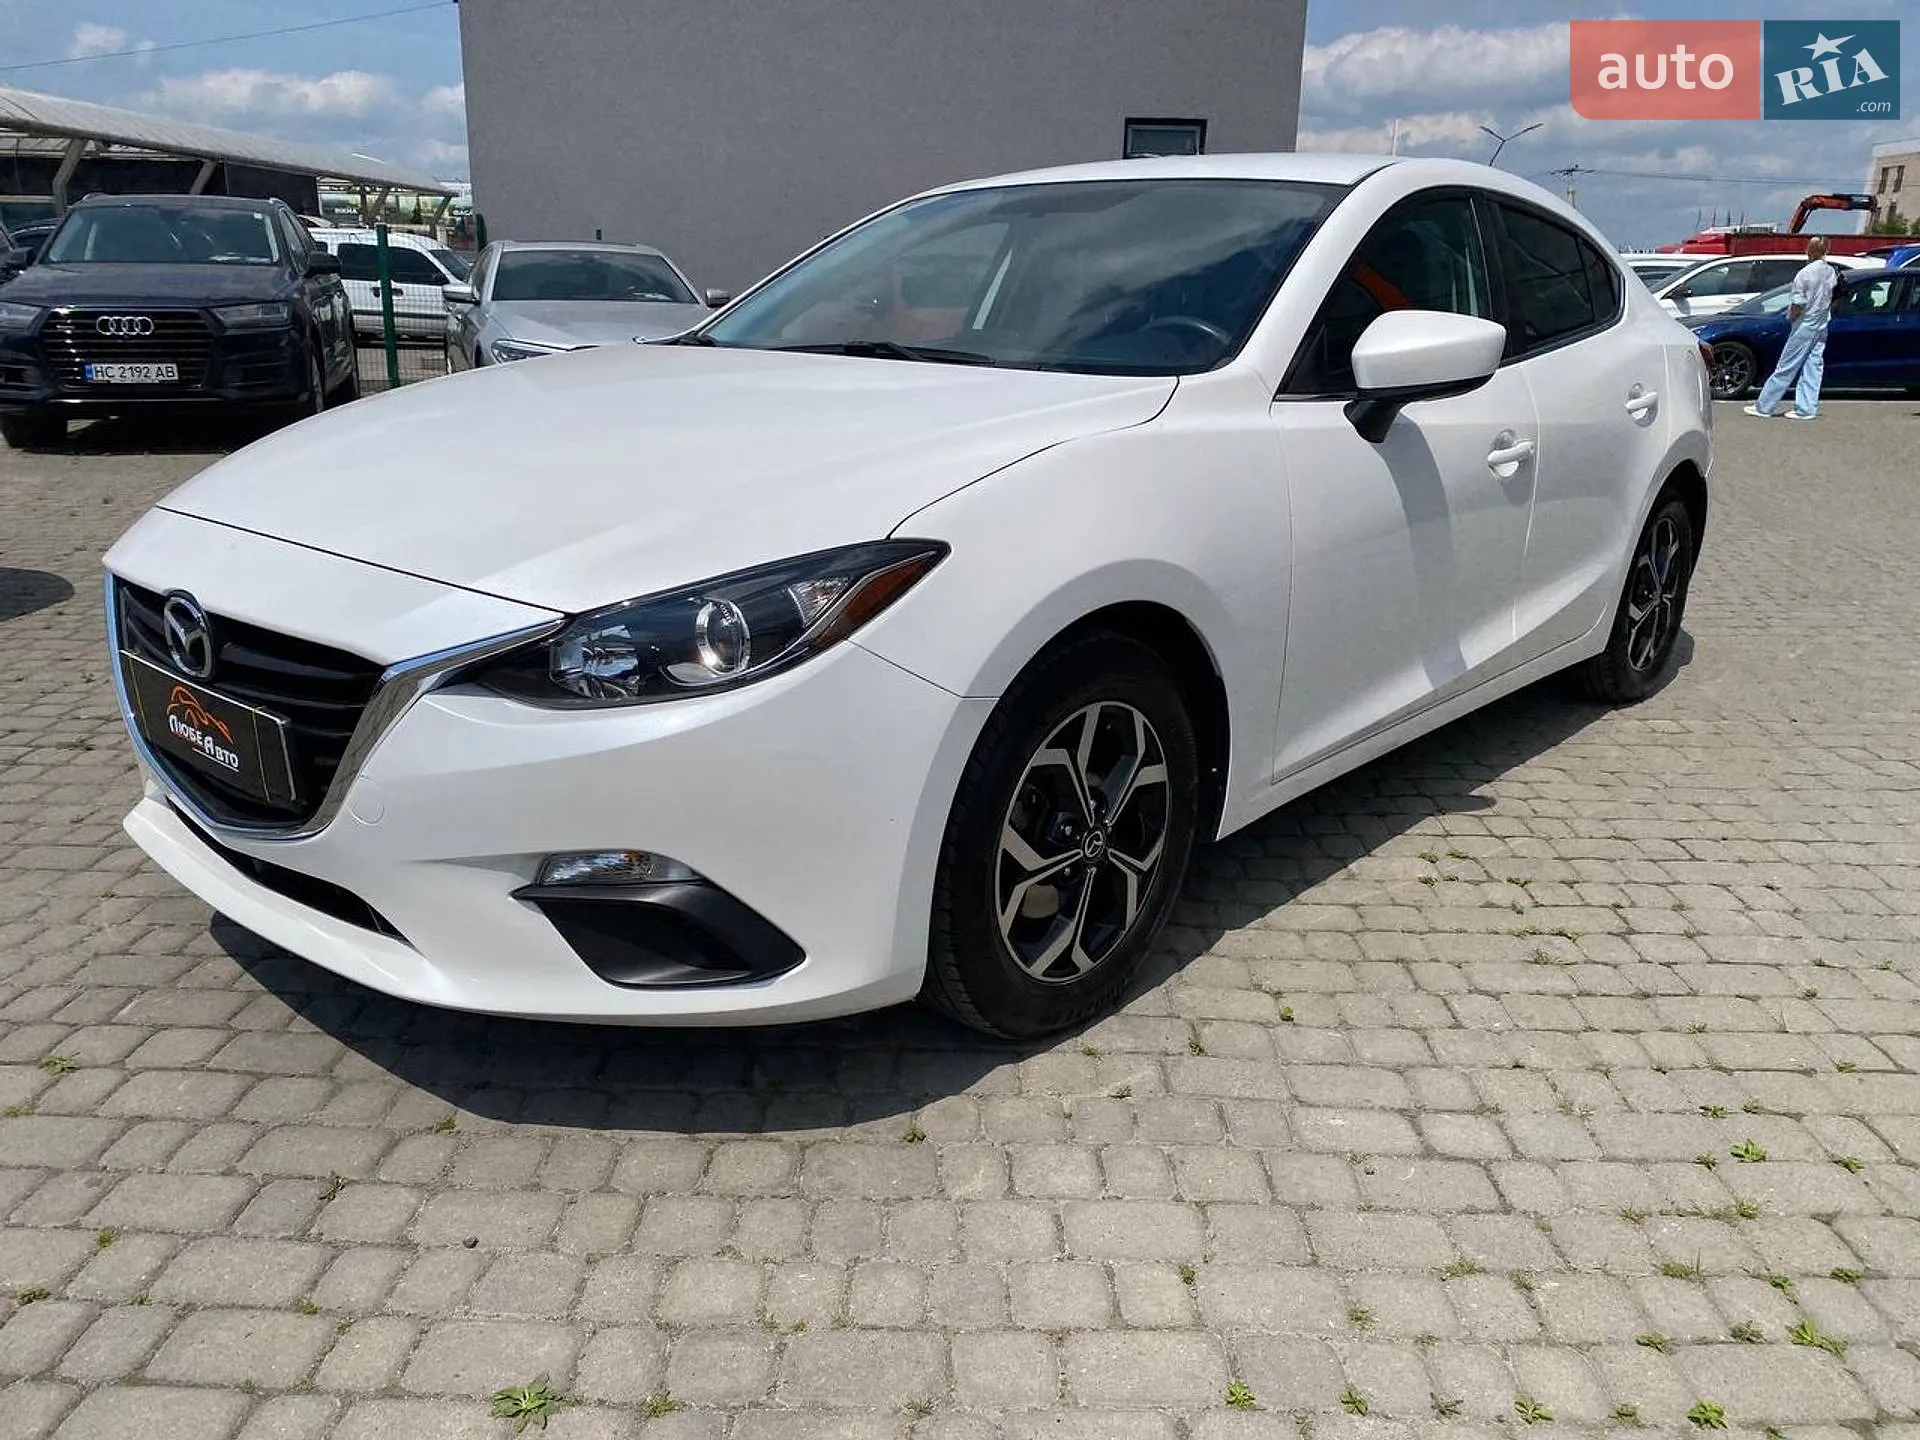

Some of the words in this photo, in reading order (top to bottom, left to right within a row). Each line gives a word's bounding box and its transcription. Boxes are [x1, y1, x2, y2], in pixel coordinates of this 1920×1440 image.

[96, 366, 115, 378] HC
[119, 366, 150, 378] 2192
[156, 366, 175, 378] AB
